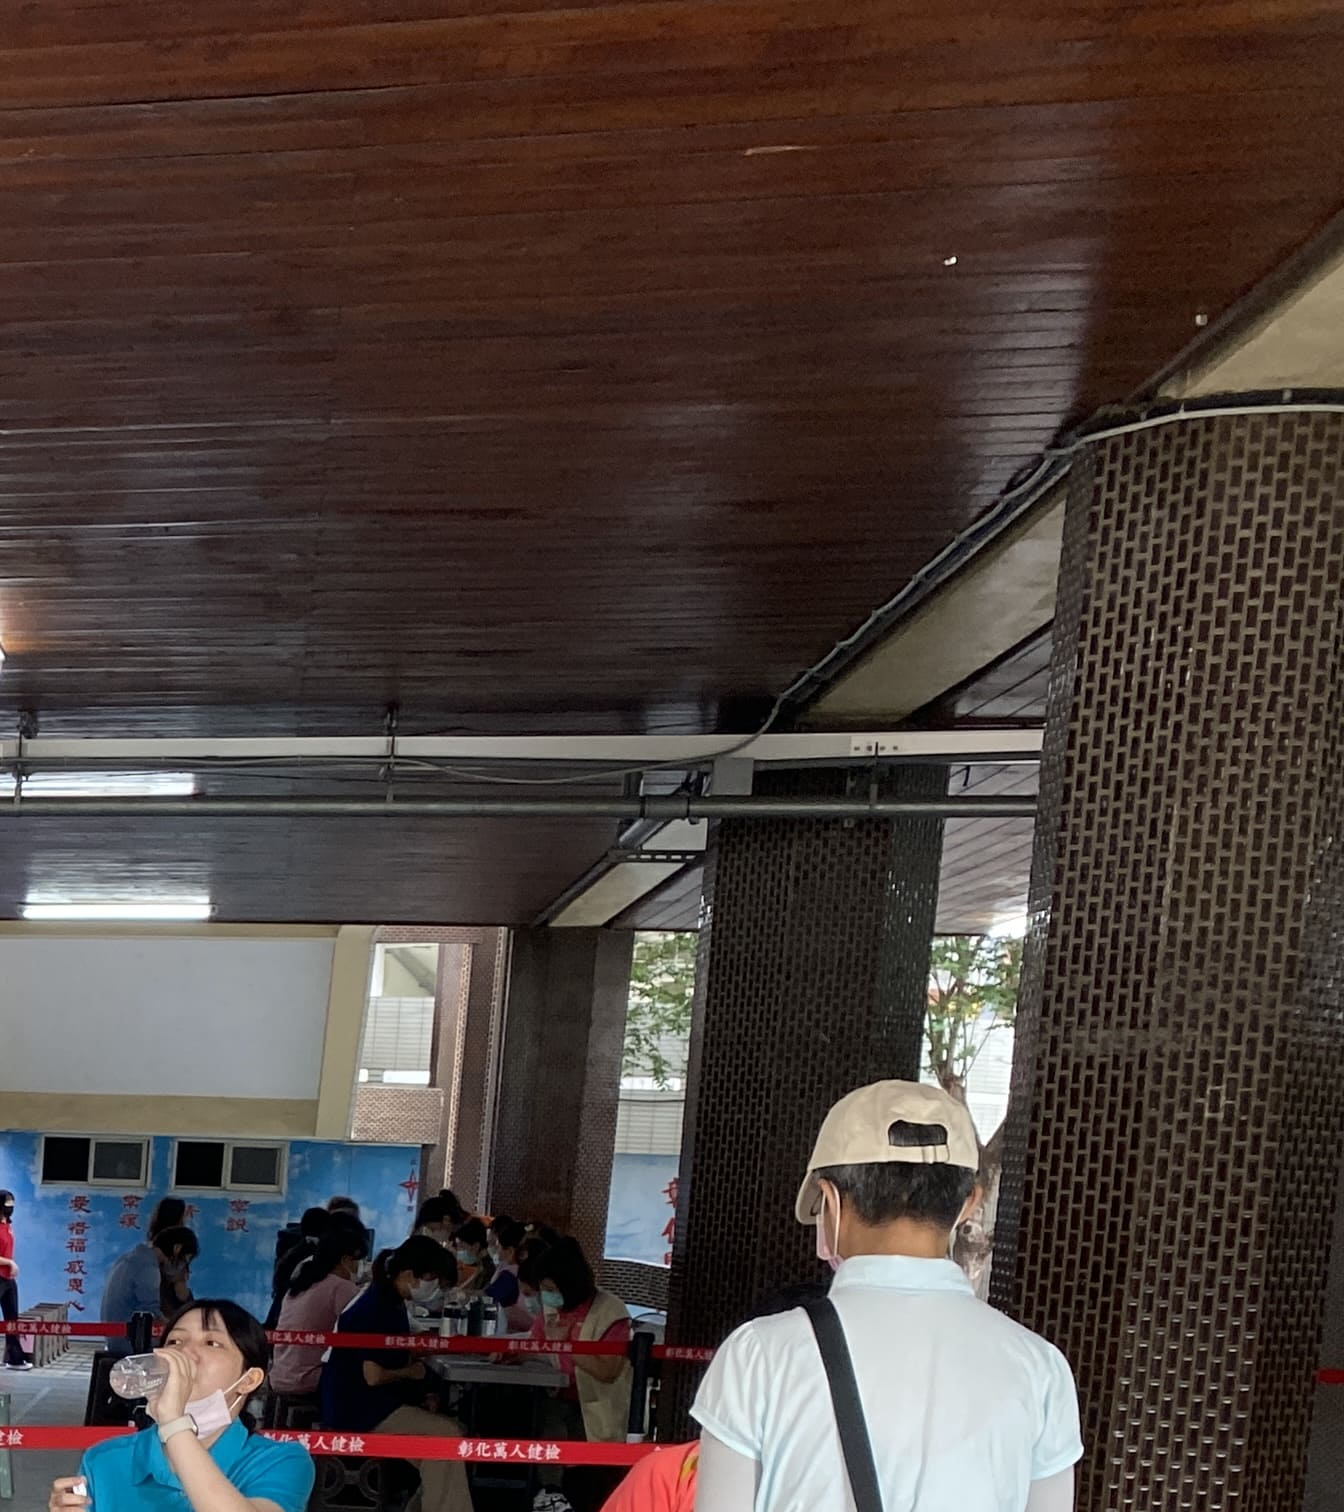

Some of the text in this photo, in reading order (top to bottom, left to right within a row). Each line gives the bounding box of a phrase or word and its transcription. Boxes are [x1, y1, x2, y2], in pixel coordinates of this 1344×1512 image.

[457, 1440, 561, 1461] 彰化萬人健檢
